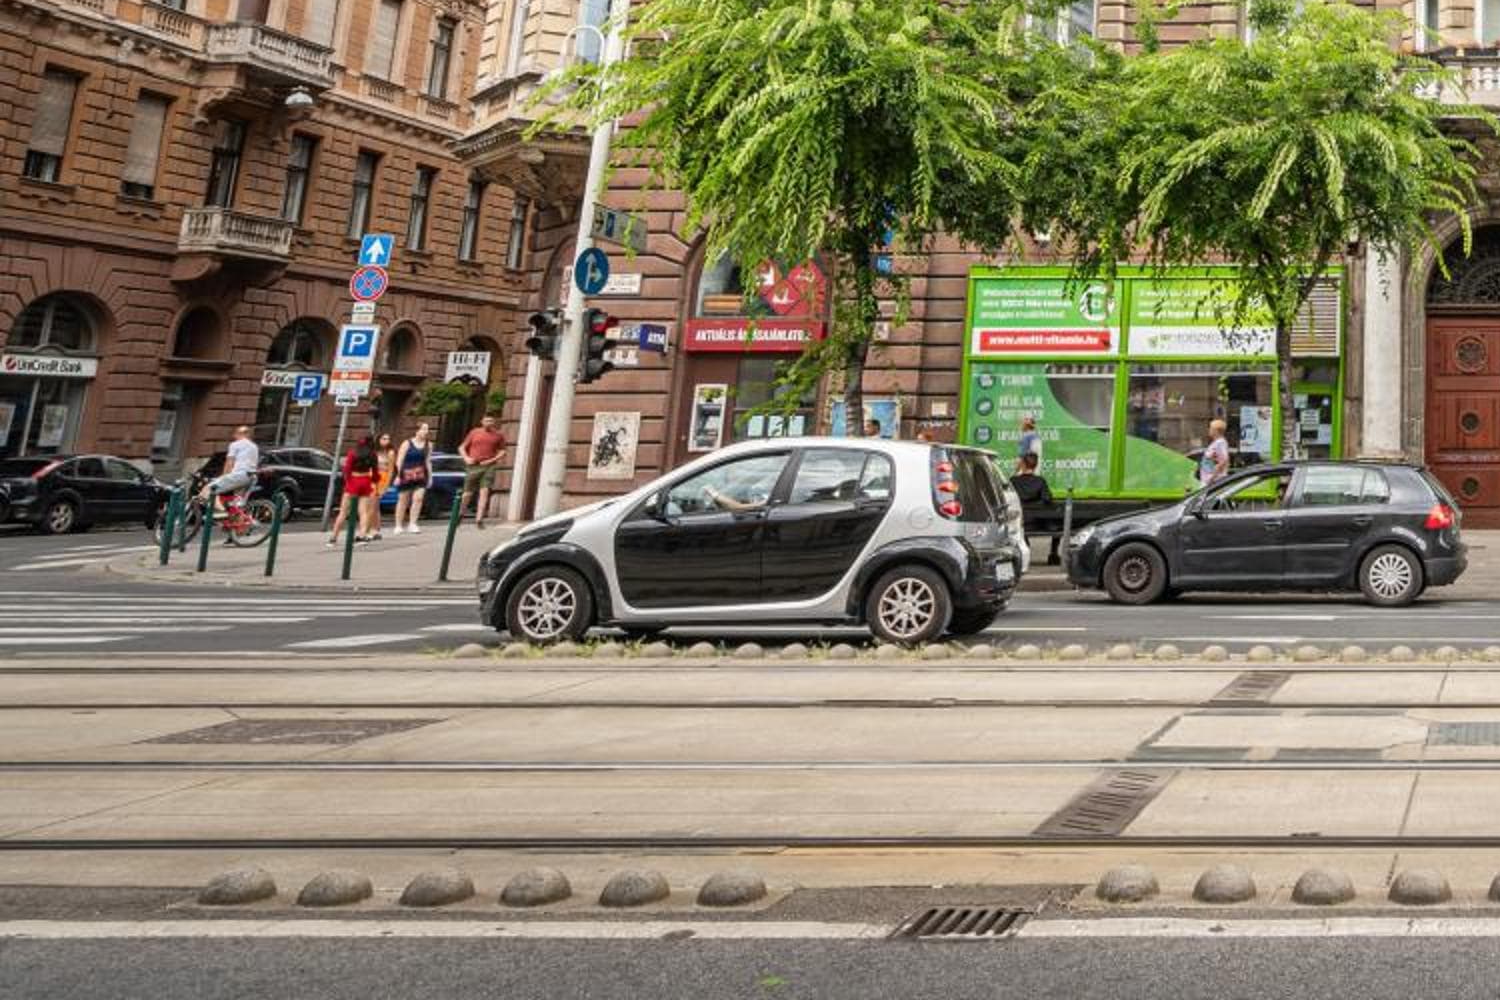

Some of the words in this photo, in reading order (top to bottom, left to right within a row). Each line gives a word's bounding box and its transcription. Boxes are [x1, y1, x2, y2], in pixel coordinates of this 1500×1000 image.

[348, 333, 367, 354] P
[18, 360, 58, 371] UniCredit
[60, 360, 82, 373] Bank
[299, 377, 317, 397] P
